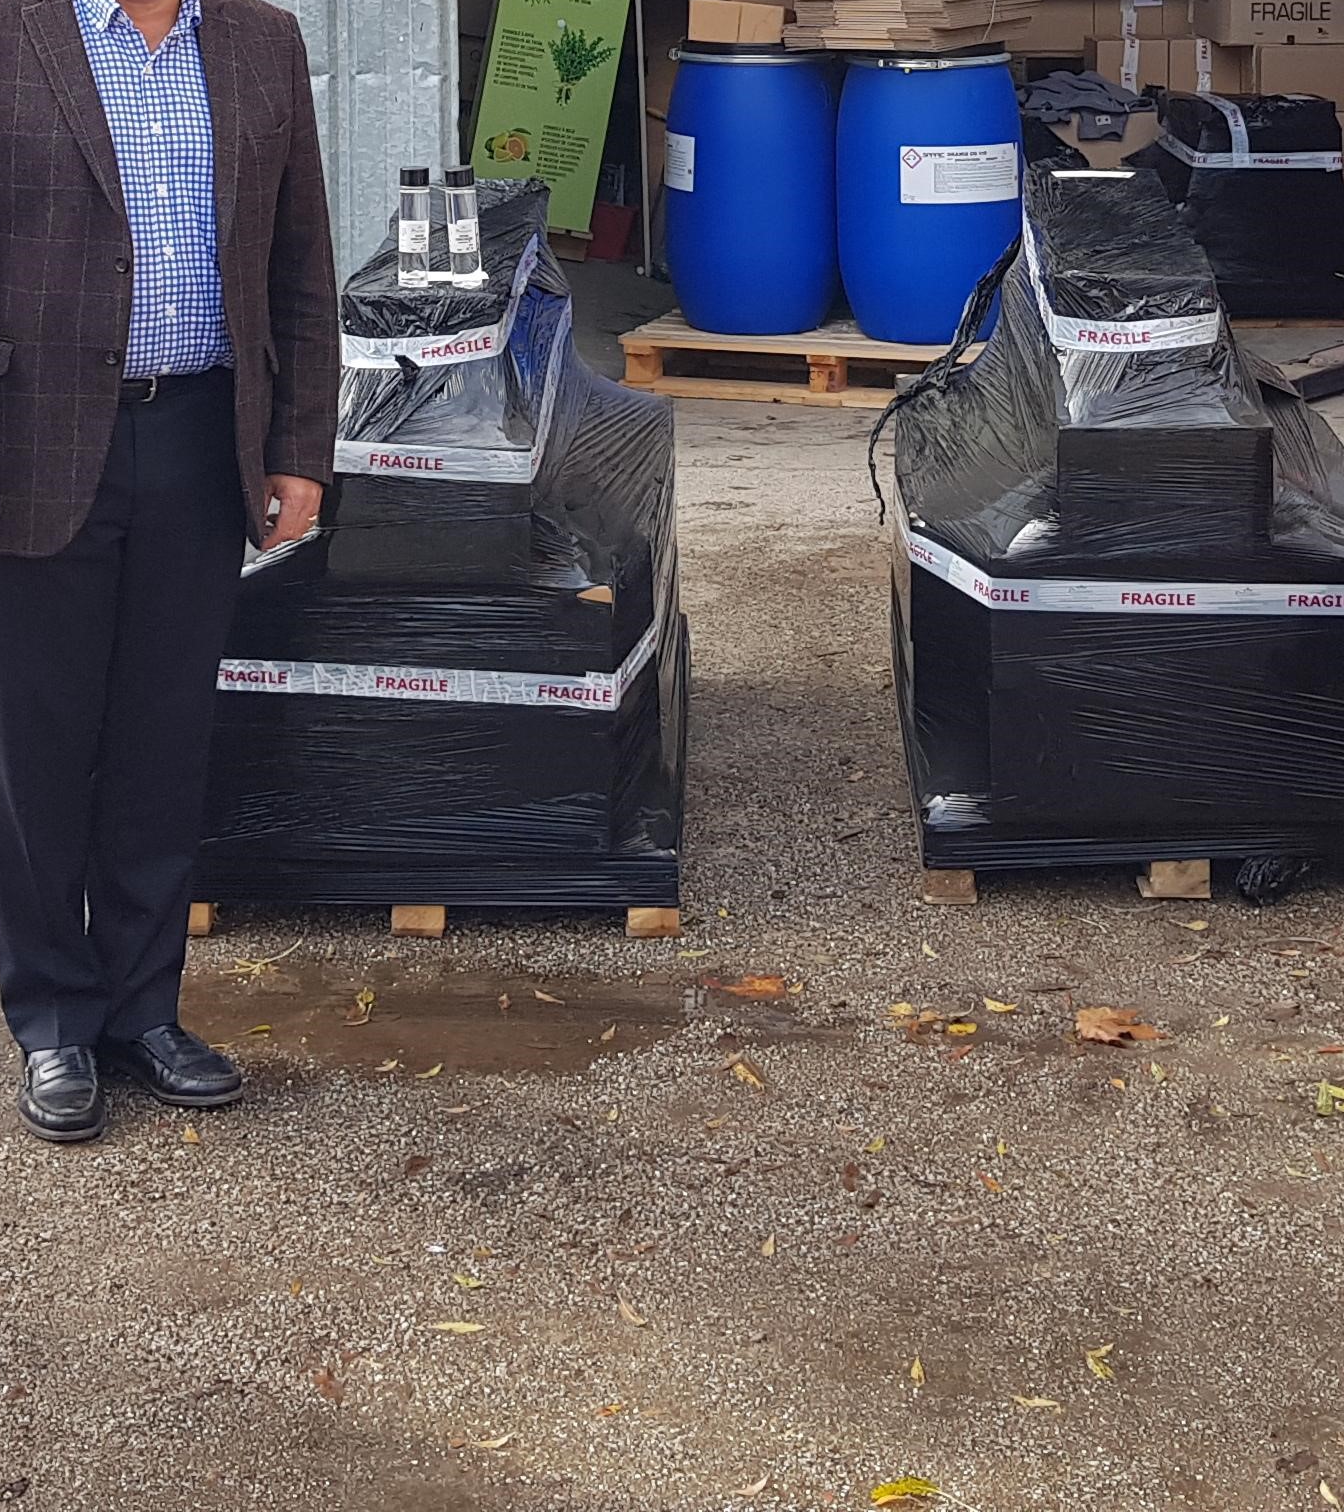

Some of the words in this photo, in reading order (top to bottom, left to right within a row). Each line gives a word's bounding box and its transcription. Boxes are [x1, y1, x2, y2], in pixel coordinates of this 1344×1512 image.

[1251, 1, 1331, 21] FRAGILE
[421, 336, 492, 359] FRAGILE
[1077, 330, 1151, 345] FRAGILE
[369, 453, 444, 471] FRAGILE
[973, 579, 1030, 602] FRAGILE
[1121, 592, 1196, 606] FRAGILE
[375, 676, 448, 692] FRAGILE
[538, 684, 613, 703] FRAGILE
